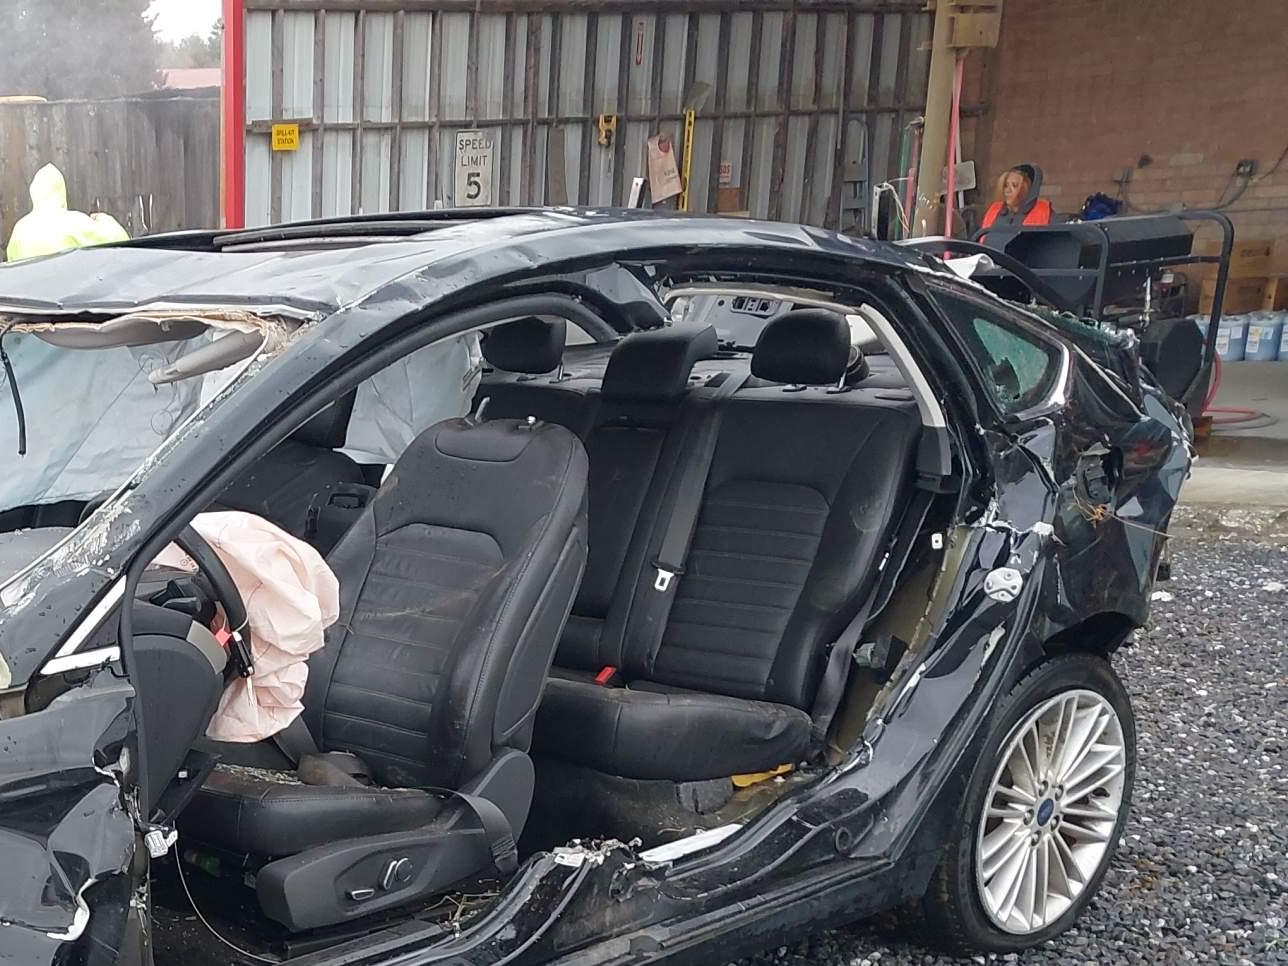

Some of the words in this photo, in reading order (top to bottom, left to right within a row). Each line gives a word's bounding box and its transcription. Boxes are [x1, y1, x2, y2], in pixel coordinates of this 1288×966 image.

[458, 138, 492, 151] SPEED
[460, 155, 488, 168] LIMIT
[465, 171, 482, 200] 5
